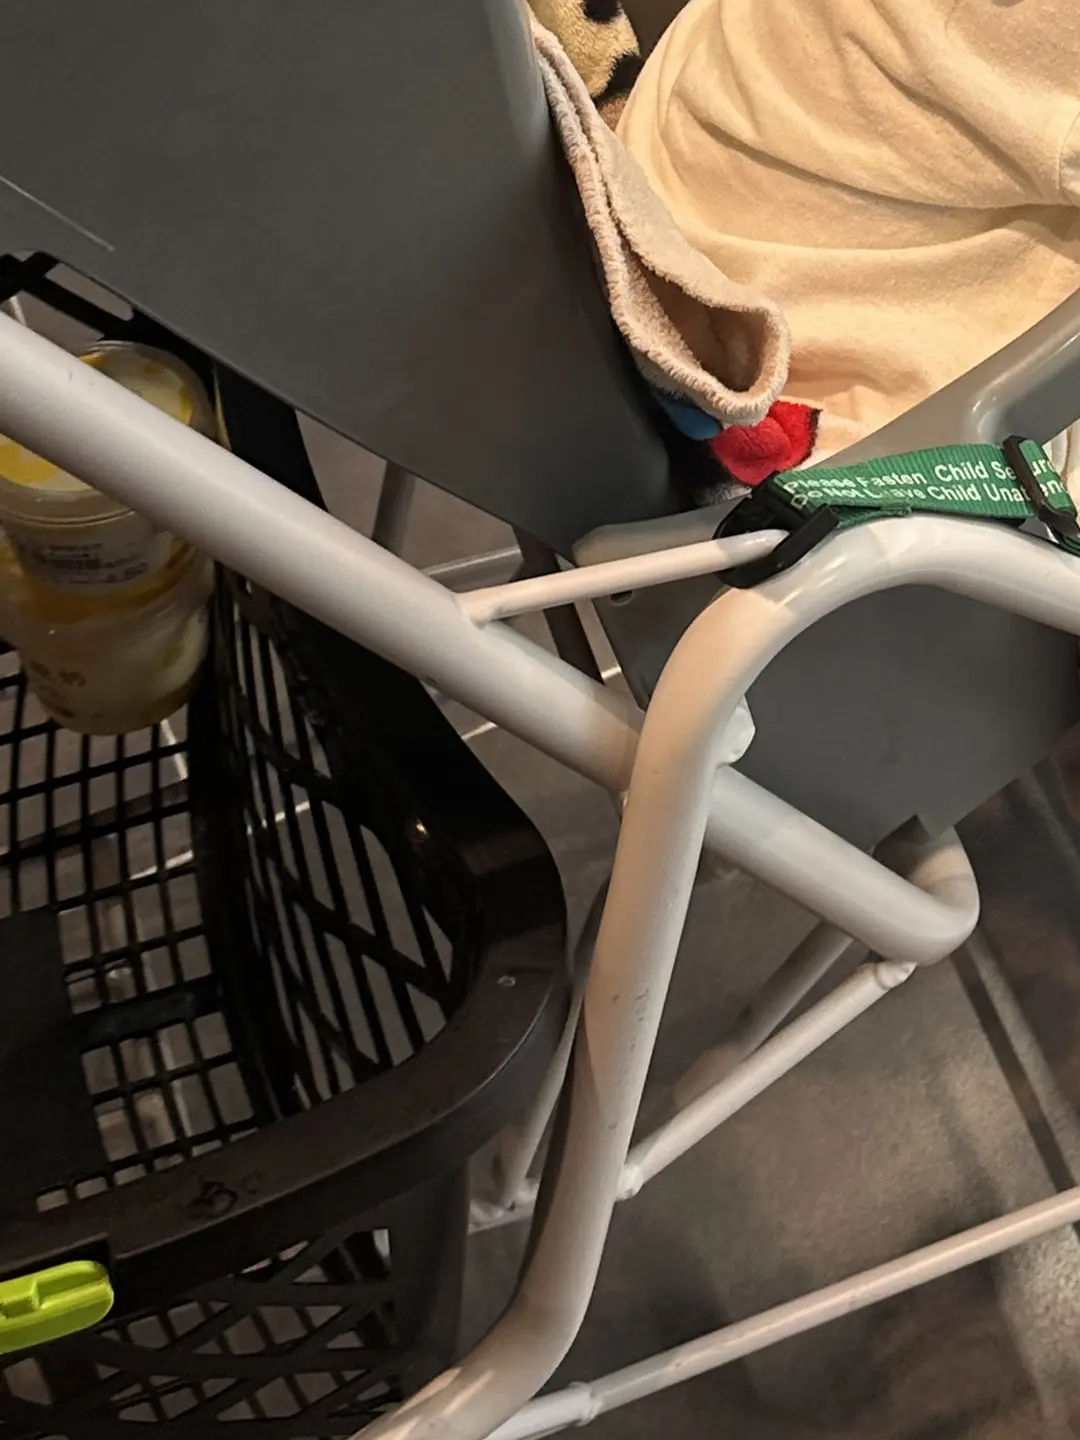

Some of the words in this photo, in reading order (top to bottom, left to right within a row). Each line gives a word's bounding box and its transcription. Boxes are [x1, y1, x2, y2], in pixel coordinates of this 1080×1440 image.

[783, 478, 857, 494] Please
[856, 472, 928, 488] Fasten
[934, 460, 989, 482] Child
[790, 490, 823, 509] Do
[927, 483, 981, 501] Child
